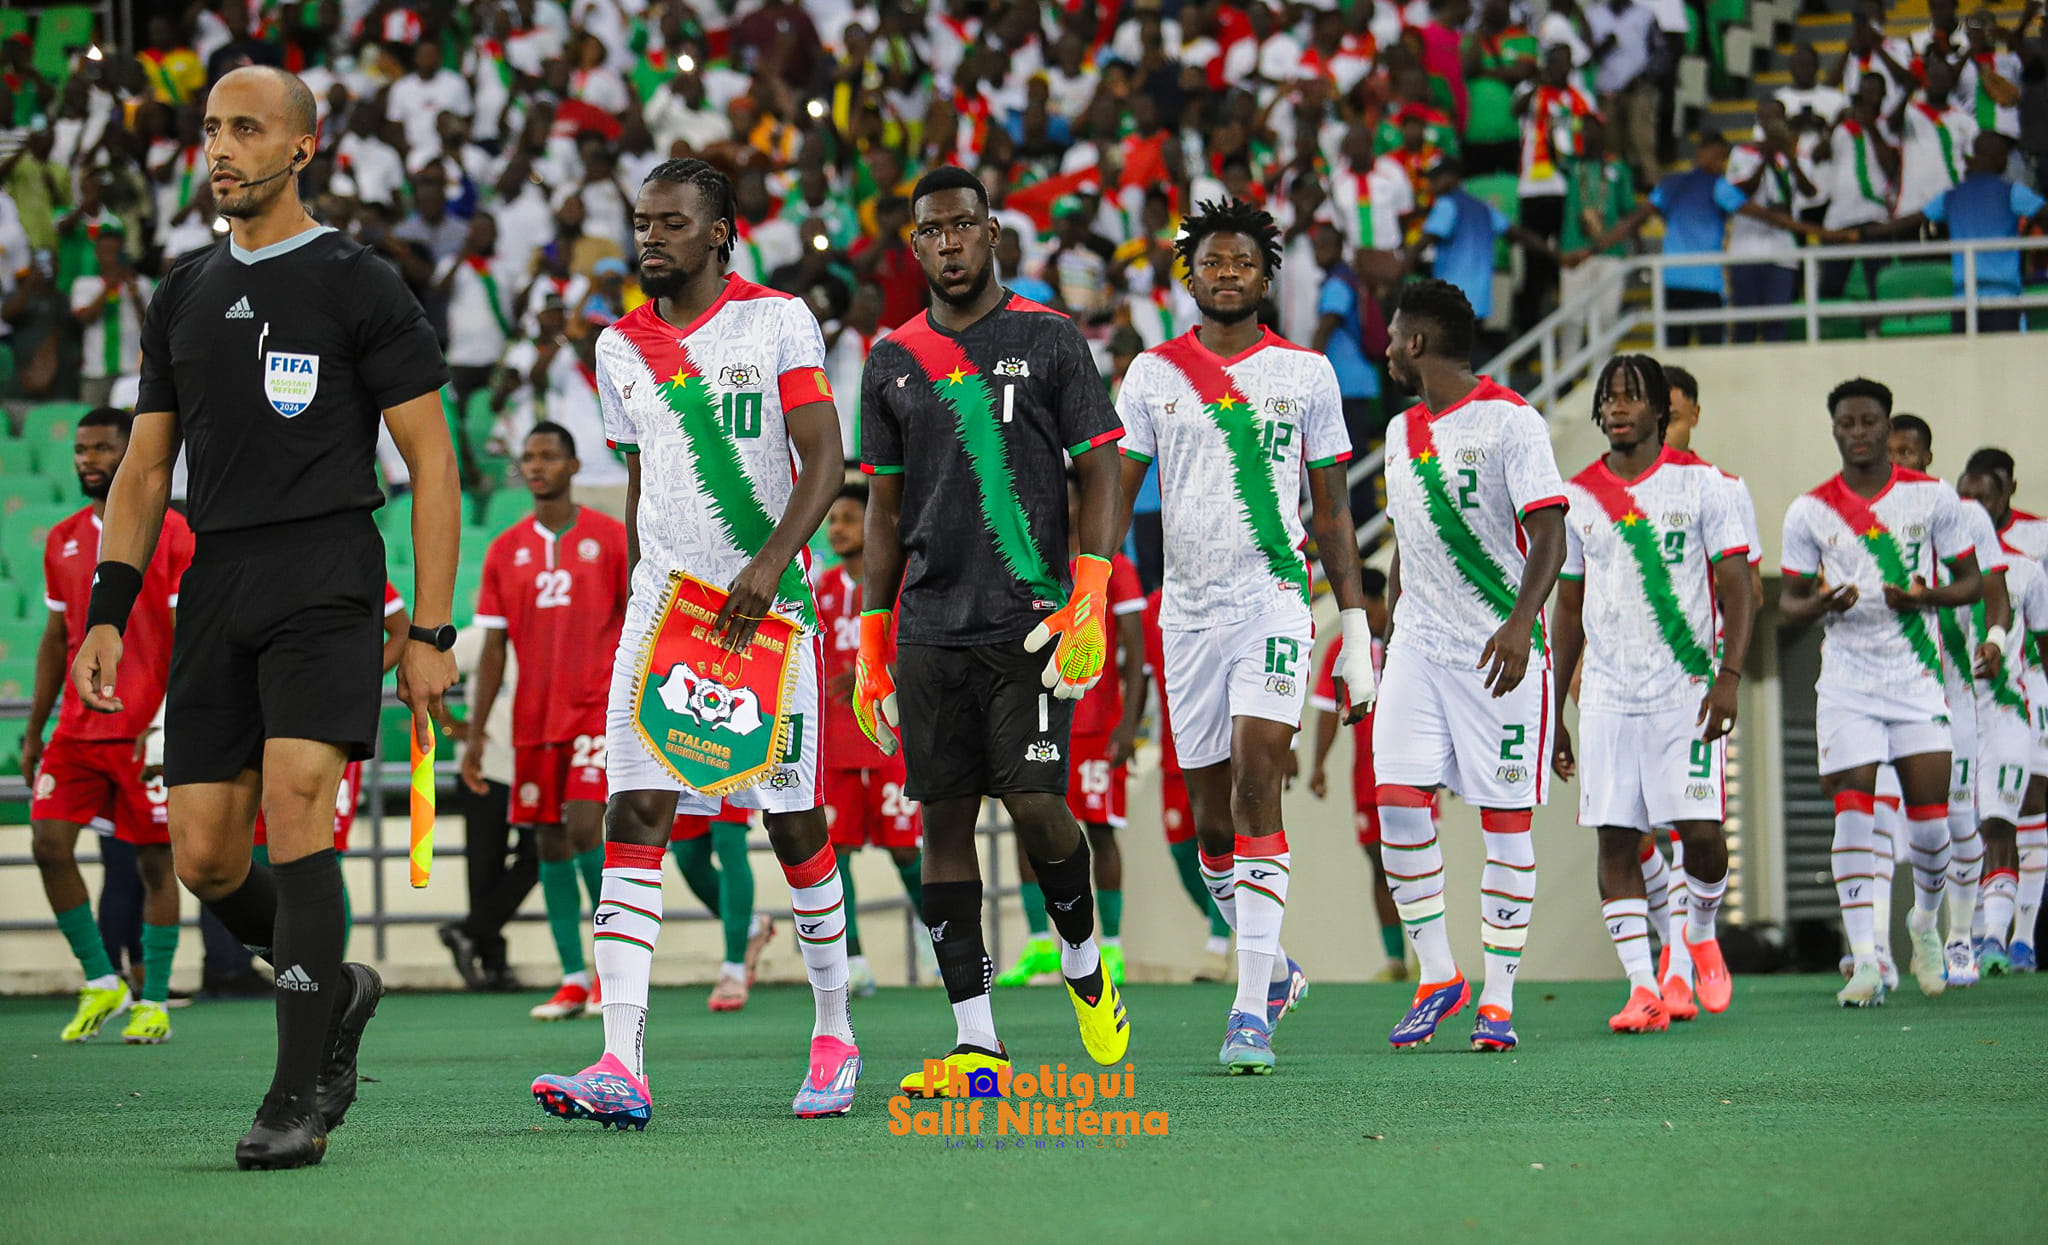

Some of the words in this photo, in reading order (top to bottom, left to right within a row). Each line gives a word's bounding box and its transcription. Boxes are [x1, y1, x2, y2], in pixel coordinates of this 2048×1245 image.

[225, 310, 254, 319] adidas
[270, 357, 313, 374] FIFA
[270, 379, 312, 388] ASSISTANT
[273, 387, 307, 395] REFEREE
[279, 403, 299, 412] 2024
[722, 392, 763, 438] 10
[1003, 384, 1015, 423] 1
[1262, 420, 1294, 462] 12
[1457, 469, 1480, 509] 2
[1664, 531, 1686, 564] 9
[1904, 542, 1921, 575] 3
[535, 569, 572, 608] 22
[690, 624, 707, 641] DE
[1265, 637, 1299, 677] 12
[1038, 693, 1049, 733] 1
[665, 742, 705, 763] BURKINA
[705, 755, 730, 771] FASO
[667, 728, 731, 760] ETALONS
[1500, 724, 1525, 760] 2
[1688, 740, 1712, 778] 9
[1954, 758, 1969, 785] 7
[1078, 759, 1110, 794] 15
[1998, 764, 2024, 792] 17
[276, 978, 319, 992] adidas
